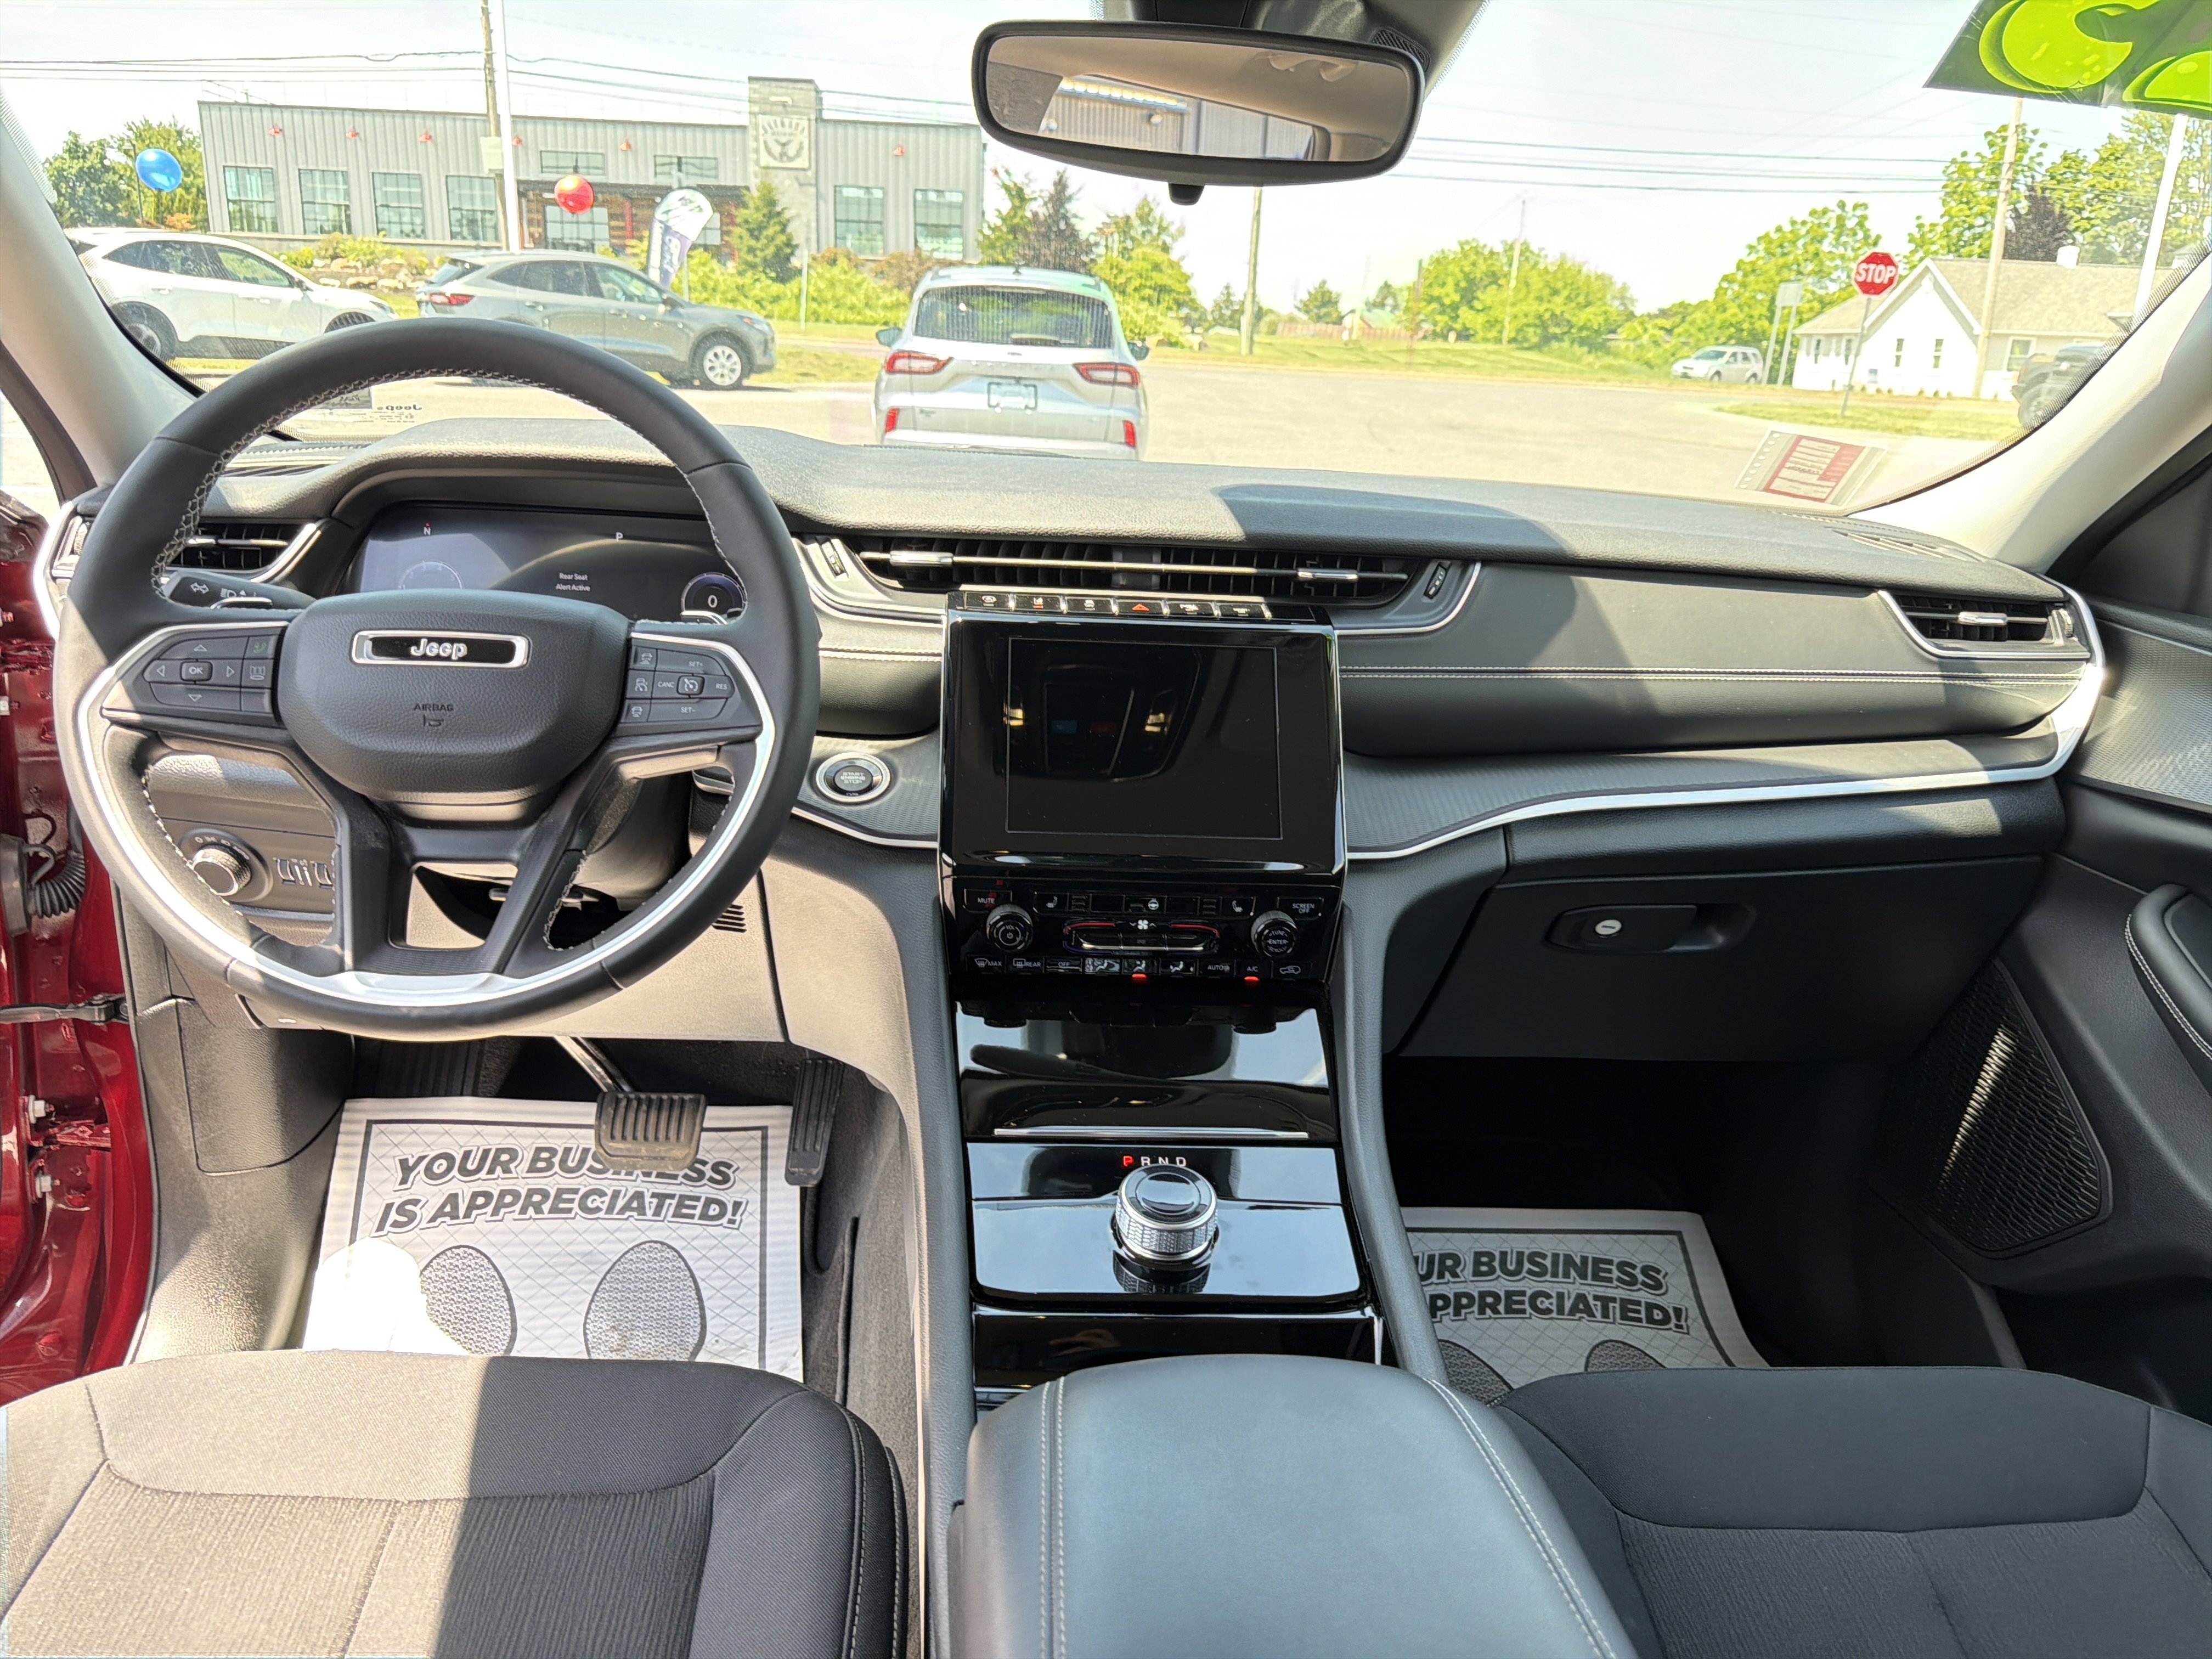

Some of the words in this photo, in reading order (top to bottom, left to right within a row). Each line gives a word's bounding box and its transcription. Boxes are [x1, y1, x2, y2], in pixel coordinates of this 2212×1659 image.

[1856, 262, 1896, 284] STOP
[424, 527, 431, 535] N
[616, 532, 623, 542] P
[708, 595, 718, 608] 0
[410, 638, 467, 660] Jeep
[189, 666, 203, 675] OK
[413, 703, 454, 712] AIRBAG
[396, 1146, 520, 1187] YOUR
[527, 1146, 736, 1187] BUSSS
[1123, 1155, 1133, 1167] P
[1141, 1156, 1150, 1166] R
[1158, 1156, 1169, 1165] N
[1176, 1156, 1186, 1167] D
[374, 1198, 424, 1234] IS
[426, 1188, 744, 1226] APPRECIATED!
[1413, 1251, 1462, 1282] UR
[1471, 1250, 1664, 1291] BUSINESS
[1429, 1289, 1686, 1330] PPRECIATED!
